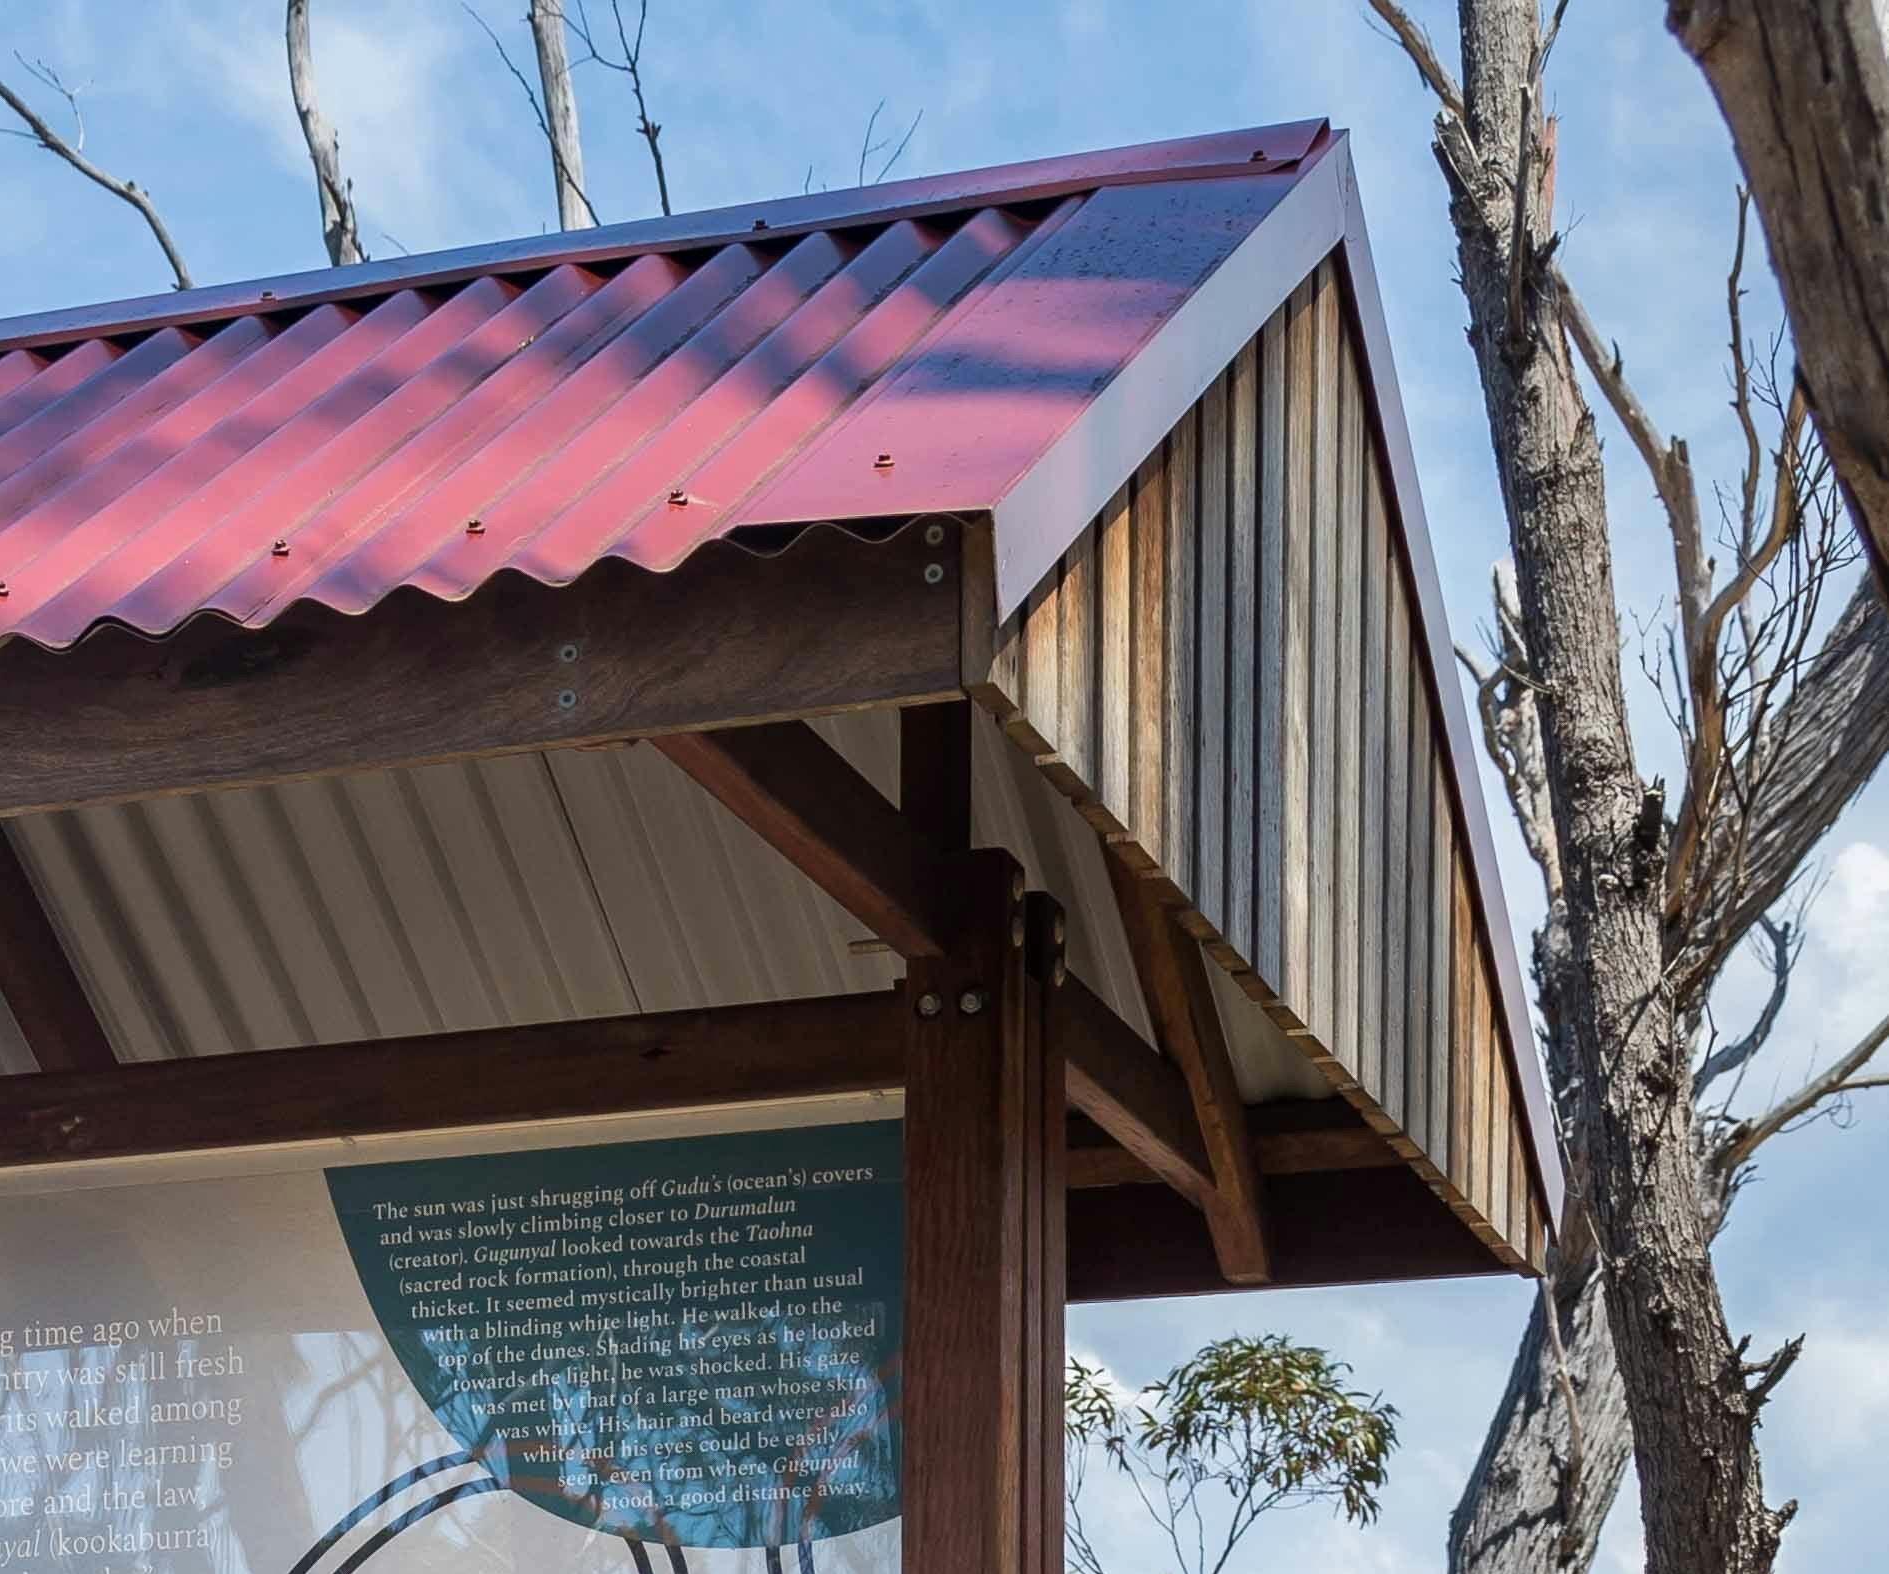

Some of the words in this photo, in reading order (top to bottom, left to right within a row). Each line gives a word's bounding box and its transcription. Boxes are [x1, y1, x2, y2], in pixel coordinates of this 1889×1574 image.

[373, 1201, 407, 1221] The
[413, 1203, 445, 1217] sun
[451, 1199, 485, 1214] was
[489, 1193, 525, 1217] just
[530, 1185, 623, 1210] shrugging
[630, 1180, 657, 1199] off
[813, 1167, 873, 1184] covers
[379, 1225, 413, 1245] and
[417, 1227, 453, 1242] was
[457, 1217, 517, 1241] slowly
[520, 1212, 603, 1234] climbing
[609, 1208, 663, 1227] closer
[669, 1207, 688, 1222] to
[694, 1196, 797, 1220] Durumalun
[389, 1248, 468, 1273] (creator).
[473, 1239, 557, 1268] Gugunyal
[561, 1234, 623, 1257] looked
[629, 1229, 704, 1251] towards
[709, 1226, 741, 1245] the
[745, 1221, 814, 1242] Taohna
[399, 1272, 463, 1297] (sacred
[469, 1269, 509, 1289] rock
[515, 1262, 617, 1286] formation),
[623, 1254, 698, 1279] through
[704, 1252, 735, 1271] the
[739, 1246, 807, 1268] coastal
[411, 1298, 479, 1319] thicket.
[485, 1297, 499, 1313] It
[505, 1289, 575, 1312] seemed
[581, 1282, 675, 1311] mystically
[681, 1277, 759, 1302] brighter
[763, 1273, 807, 1292] than
[813, 1267, 863, 1288] usual
[23, 1318, 84, 1348] time
[93, 1320, 139, 1350] ago
[147, 1308, 223, 1339] when
[423, 1323, 463, 1343] with
[470, 1327, 479, 1340] a
[485, 1318, 563, 1340] blinding
[569, 1313, 621, 1332] white
[627, 1308, 675, 1333] light.
[682, 1307, 709, 1324] He
[713, 1299, 781, 1322] walked
[787, 1301, 805, 1317] to
[811, 1296, 843, 1315] the
[57, 1364, 105, 1387] was
[115, 1351, 165, 1383] still
[175, 1346, 245, 1379] fresh
[438, 1352, 467, 1372] top
[473, 1346, 492, 1365] of
[496, 1344, 525, 1363] the
[531, 1342, 591, 1361] dunes.
[596, 1335, 671, 1357] Shading
[679, 1332, 706, 1350] his
[711, 1333, 751, 1353] eyes
[757, 1331, 777, 1344] as
[783, 1324, 805, 1342] he
[811, 1318, 875, 1340] looked
[45, 1395, 140, 1430] walked
[150, 1397, 243, 1426] among
[45, 1448, 110, 1472] were
[119, 1434, 233, 1469] learning
[43, 1483, 91, 1514] and
[101, 1480, 145, 1510] the
[154, 1478, 207, 1509] law,
